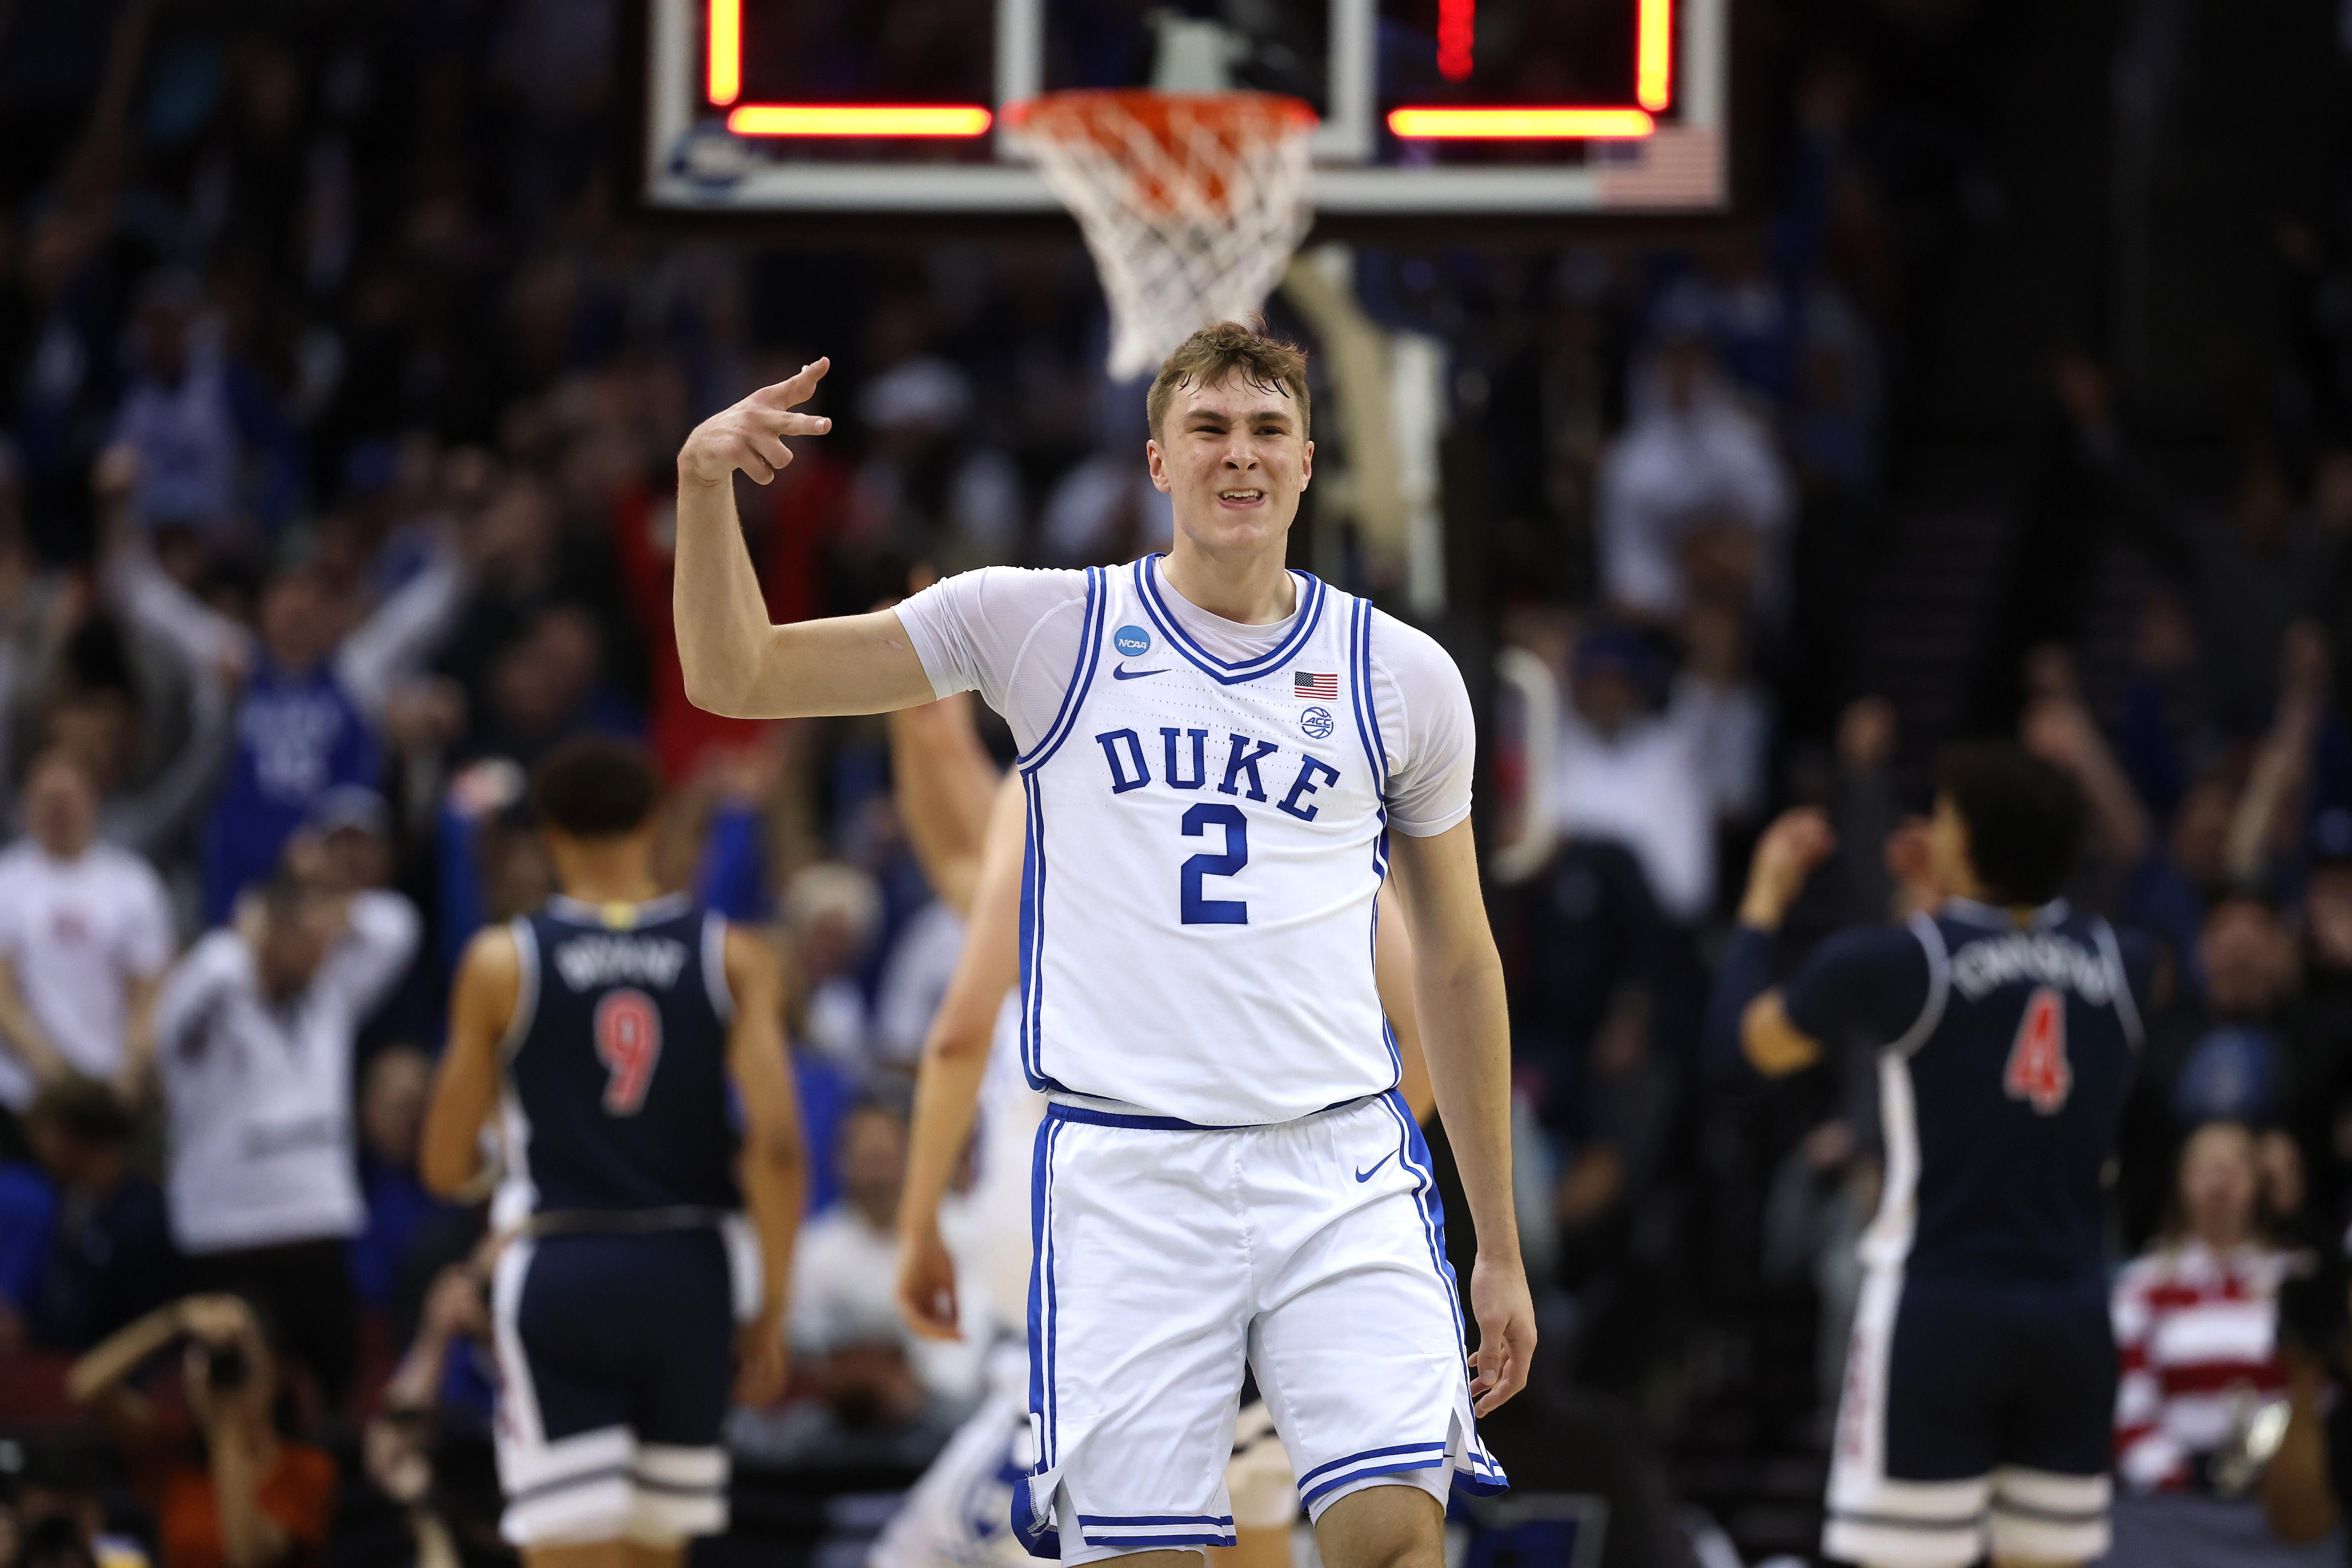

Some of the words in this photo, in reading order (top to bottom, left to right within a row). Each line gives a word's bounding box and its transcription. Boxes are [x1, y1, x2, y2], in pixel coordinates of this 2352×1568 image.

[1118, 639, 1147, 649] NCAA
[1095, 728, 1340, 822] DUKE
[1305, 717, 1332, 726] ACC
[1181, 803, 1248, 924] 2
[594, 987, 663, 1117] 9
[2003, 987, 2074, 1115] 4
